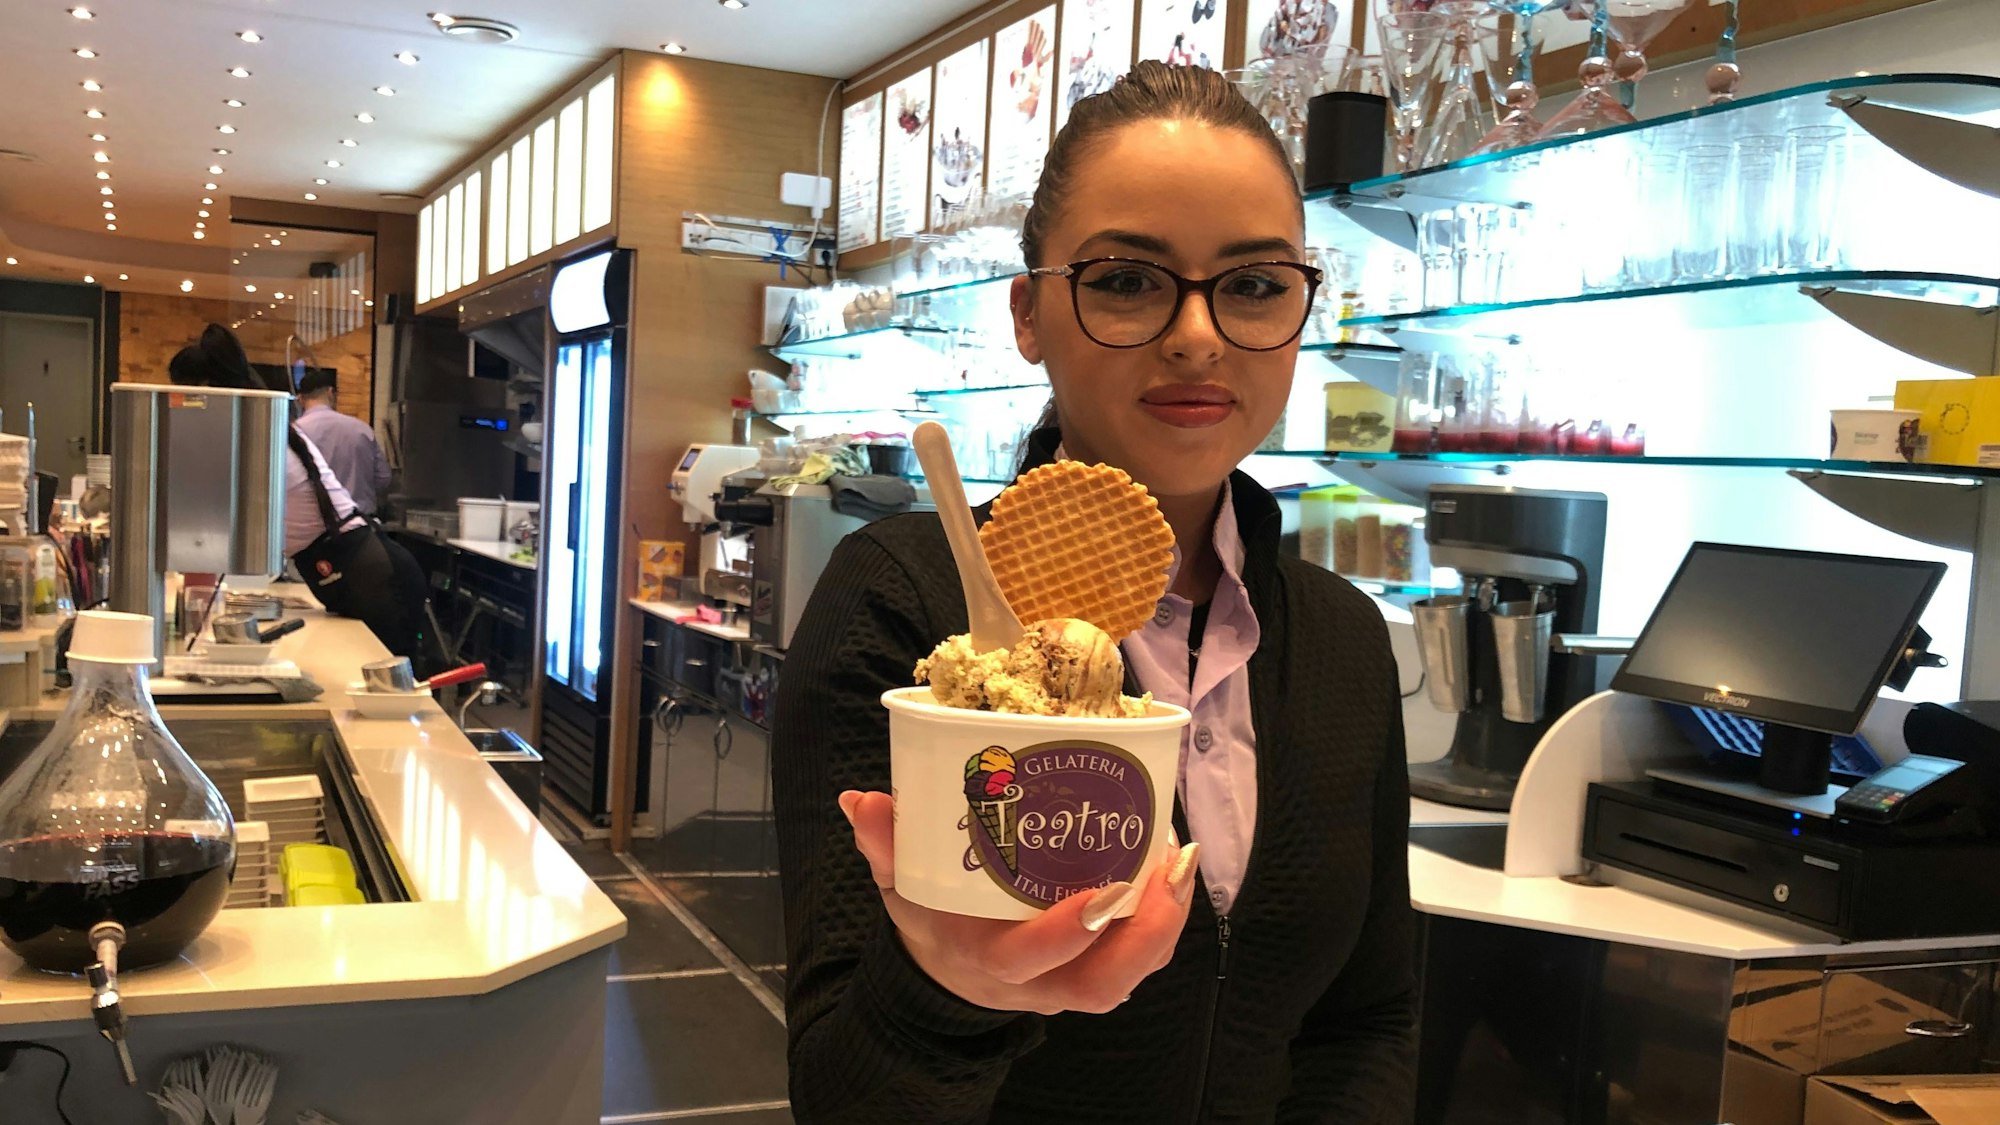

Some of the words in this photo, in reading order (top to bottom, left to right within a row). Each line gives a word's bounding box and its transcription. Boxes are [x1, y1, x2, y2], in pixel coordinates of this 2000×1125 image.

[1024, 754, 1125, 781] GELATERIA
[982, 784, 1143, 851] Teatro
[1013, 874, 1052, 901] ITAL.
